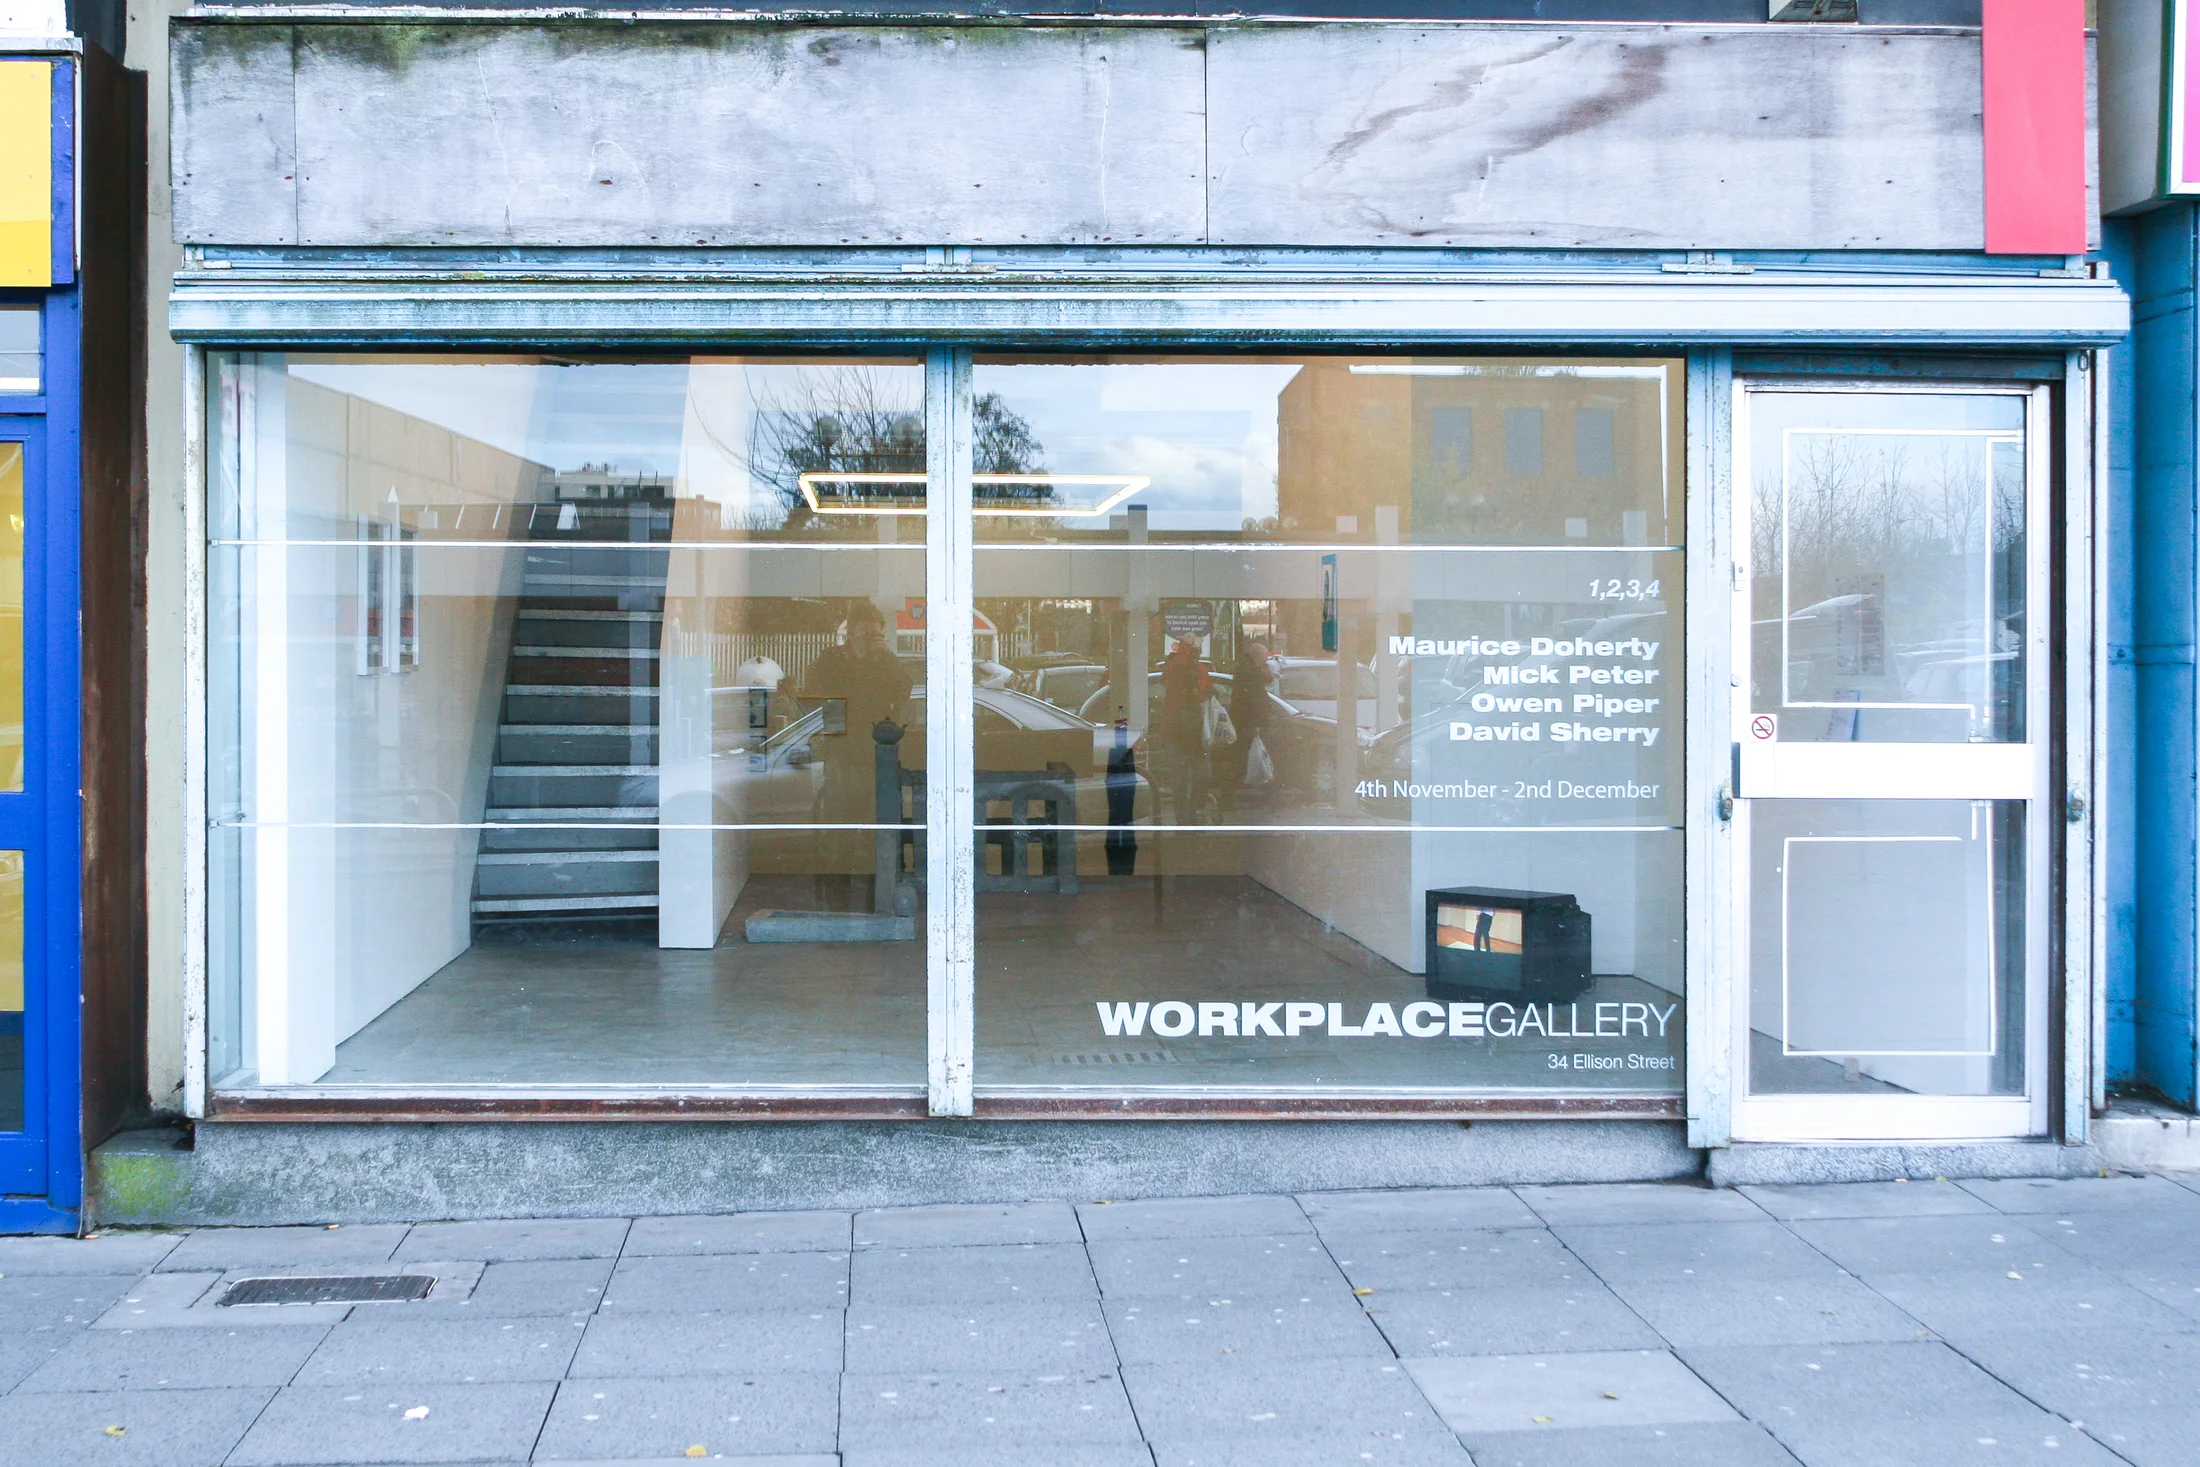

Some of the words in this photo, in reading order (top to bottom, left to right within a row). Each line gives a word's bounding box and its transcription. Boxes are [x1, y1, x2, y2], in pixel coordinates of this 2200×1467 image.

[1589, 578, 1660, 601] 1,2,3,4
[1388, 635, 1521, 656] Maurice
[1530, 636, 1660, 661] Doherty
[1483, 665, 1560, 685] Mick
[1569, 665, 1660, 685] Peter
[1471, 693, 1563, 714] Owen
[1573, 693, 1660, 718] Piper
[1449, 721, 1540, 742] David
[1550, 722, 1660, 747] Sherry
[1354, 779, 1387, 799] 4th
[1393, 779, 1497, 799] November
[1514, 780, 1551, 799] 2nd
[1558, 780, 1660, 799] December
[1547, 1053, 1569, 1070] 34
[1573, 1053, 1623, 1070] Ellison
[1627, 1053, 1676, 1070] Street
